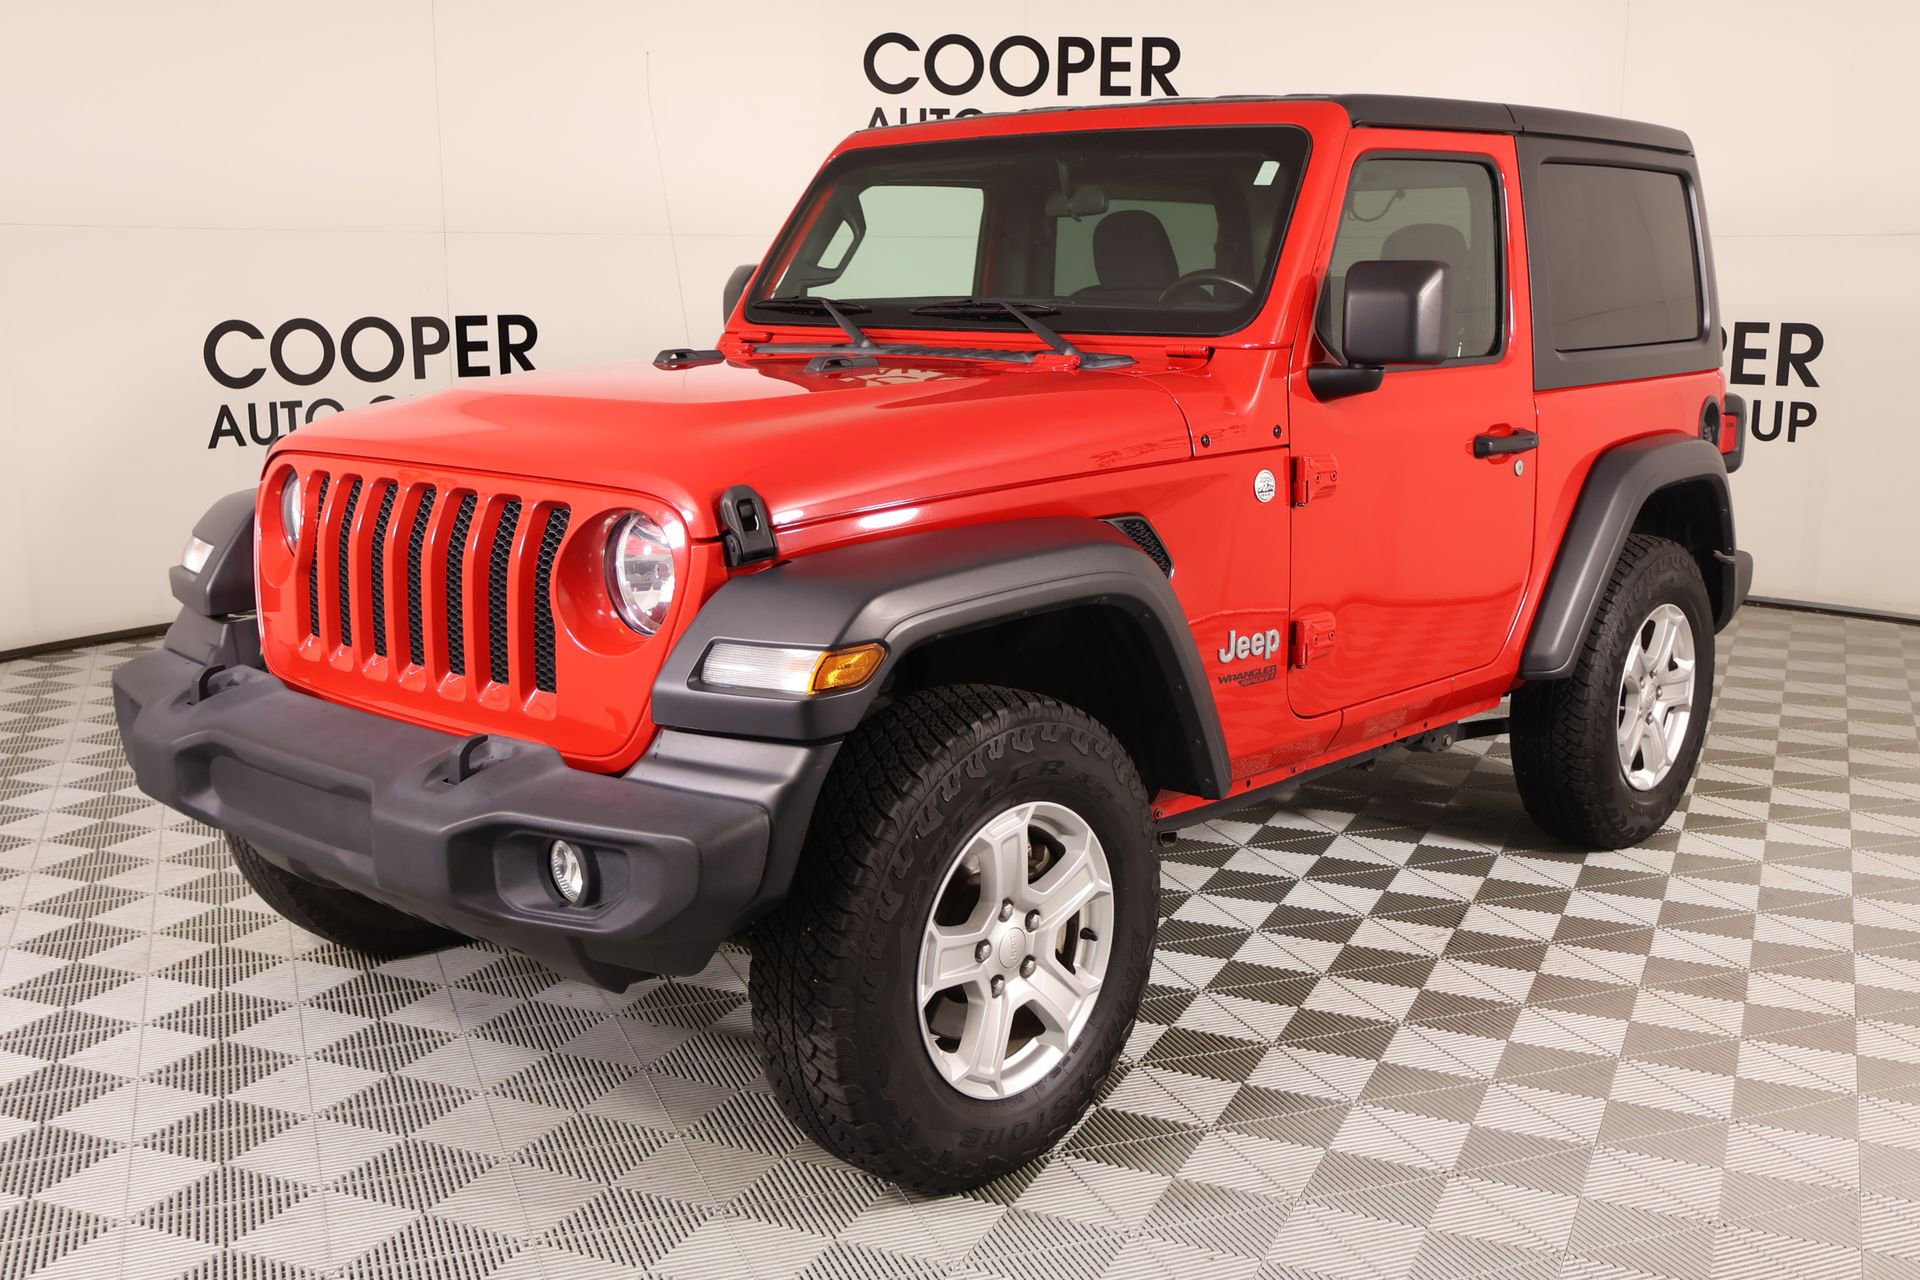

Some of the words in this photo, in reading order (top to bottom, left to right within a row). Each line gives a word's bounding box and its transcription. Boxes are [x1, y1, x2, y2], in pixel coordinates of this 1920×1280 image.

[863, 32, 1181, 97] COOPER
[203, 314, 538, 389] COOPER
[1721, 321, 1825, 388] ER
[1750, 399, 1818, 443] UP
[1218, 628, 1280, 664] Jeep
[1217, 664, 1278, 685] WRANGLER
